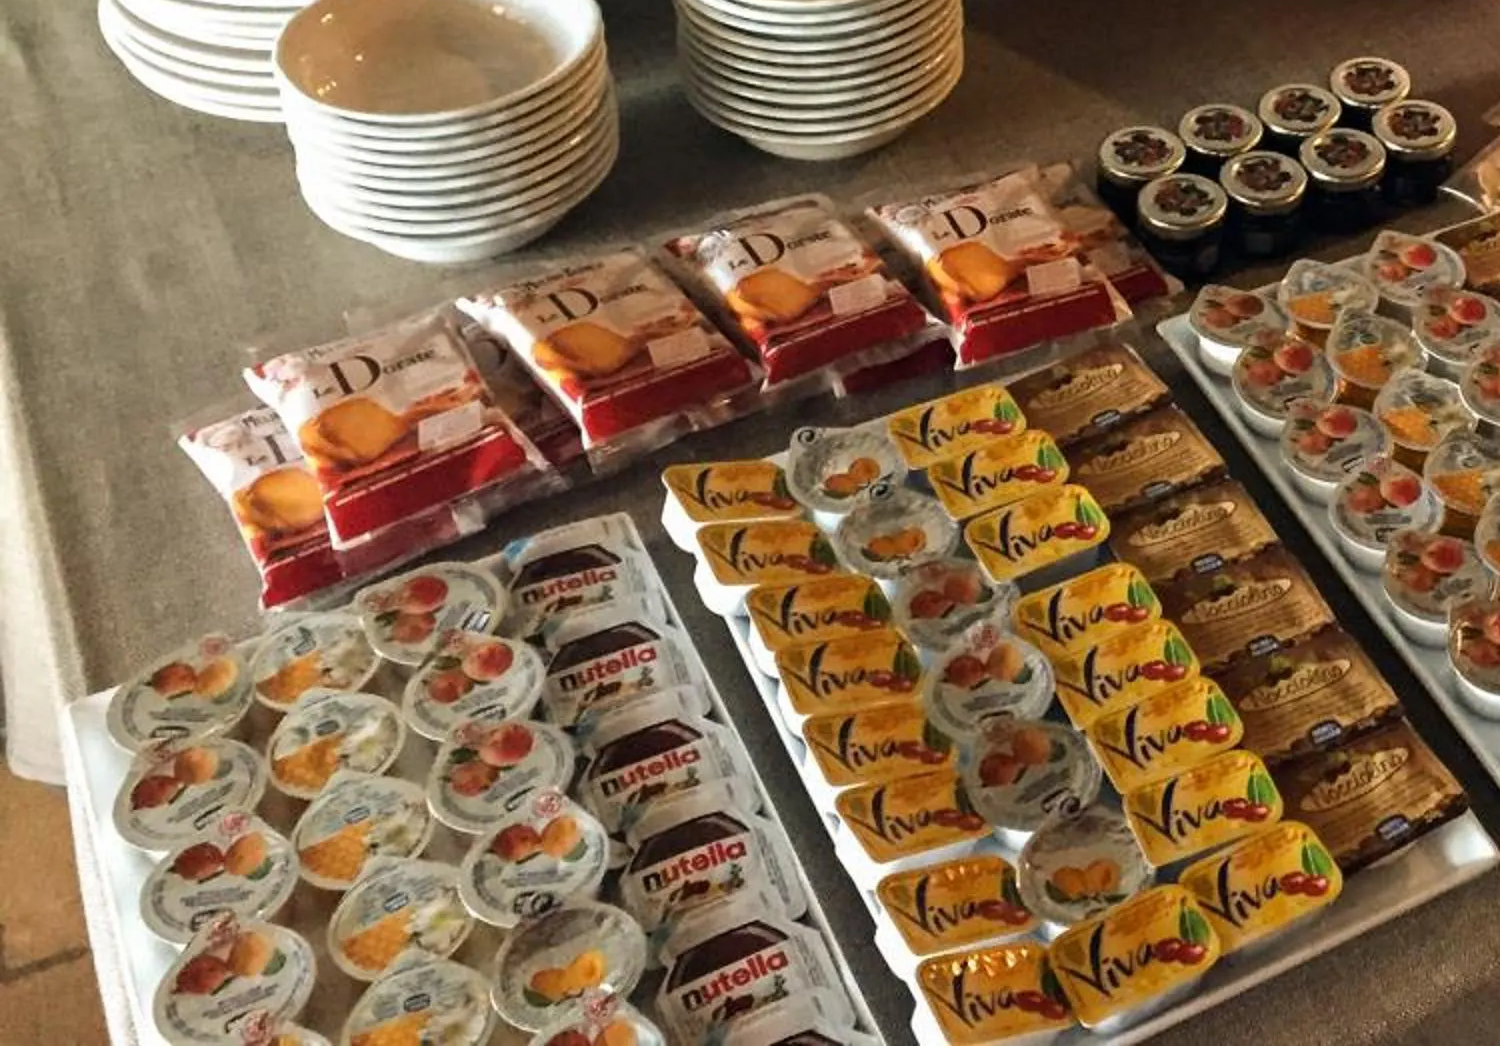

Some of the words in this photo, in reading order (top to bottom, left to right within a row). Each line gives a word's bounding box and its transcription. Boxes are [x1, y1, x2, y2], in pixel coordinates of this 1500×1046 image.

[329, 348, 436, 396] Dorate
[898, 407, 973, 452] Viva
[680, 467, 753, 512] Viva
[936, 451, 1018, 500] Viva
[711, 527, 788, 576] Viva
[971, 509, 1059, 564] Viva
[522, 568, 617, 605] nutella
[755, 586, 841, 636] Viva
[1019, 589, 1108, 646] Viva
[559, 643, 657, 692] nutella
[788, 642, 870, 699] Viva
[1059, 646, 1142, 705] Viva
[813, 715, 899, 773] Viva
[1098, 707, 1187, 769] Viva
[600, 746, 702, 797] nutella
[847, 786, 937, 844] Viva
[1132, 779, 1228, 844] Viva
[642, 838, 747, 894] nutella
[1197, 857, 1280, 929] Viva
[888, 875, 981, 938] Viva
[680, 950, 789, 1012] nutella
[1059, 923, 1156, 997] Viva
[928, 968, 1020, 1029] Viva
